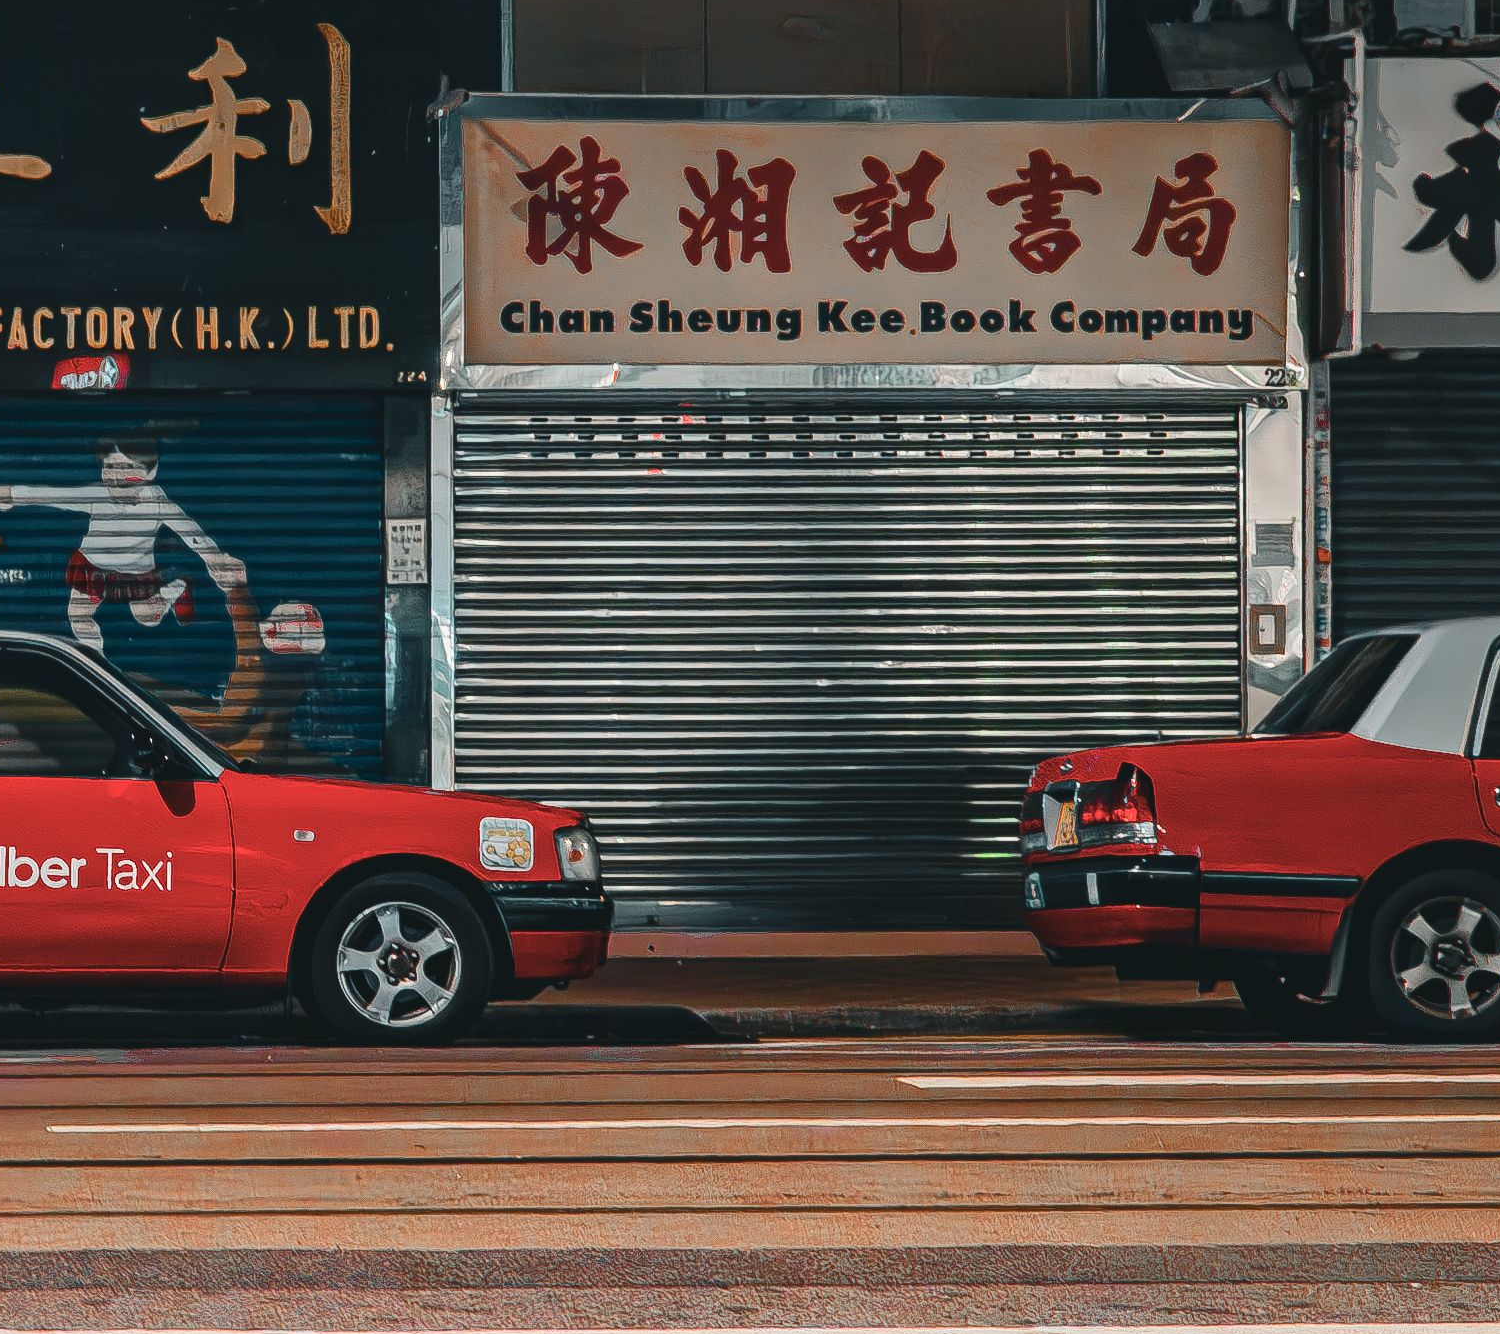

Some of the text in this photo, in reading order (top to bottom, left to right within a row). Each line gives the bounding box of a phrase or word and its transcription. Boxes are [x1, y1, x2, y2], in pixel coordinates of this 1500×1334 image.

[516, 134, 1240, 276] 陳湘記書局
[308, 306, 394, 351] LTD.
[500, 300, 1254, 341] Chan Sheung Kee Book Company
[95, 847, 173, 892] Taxi
